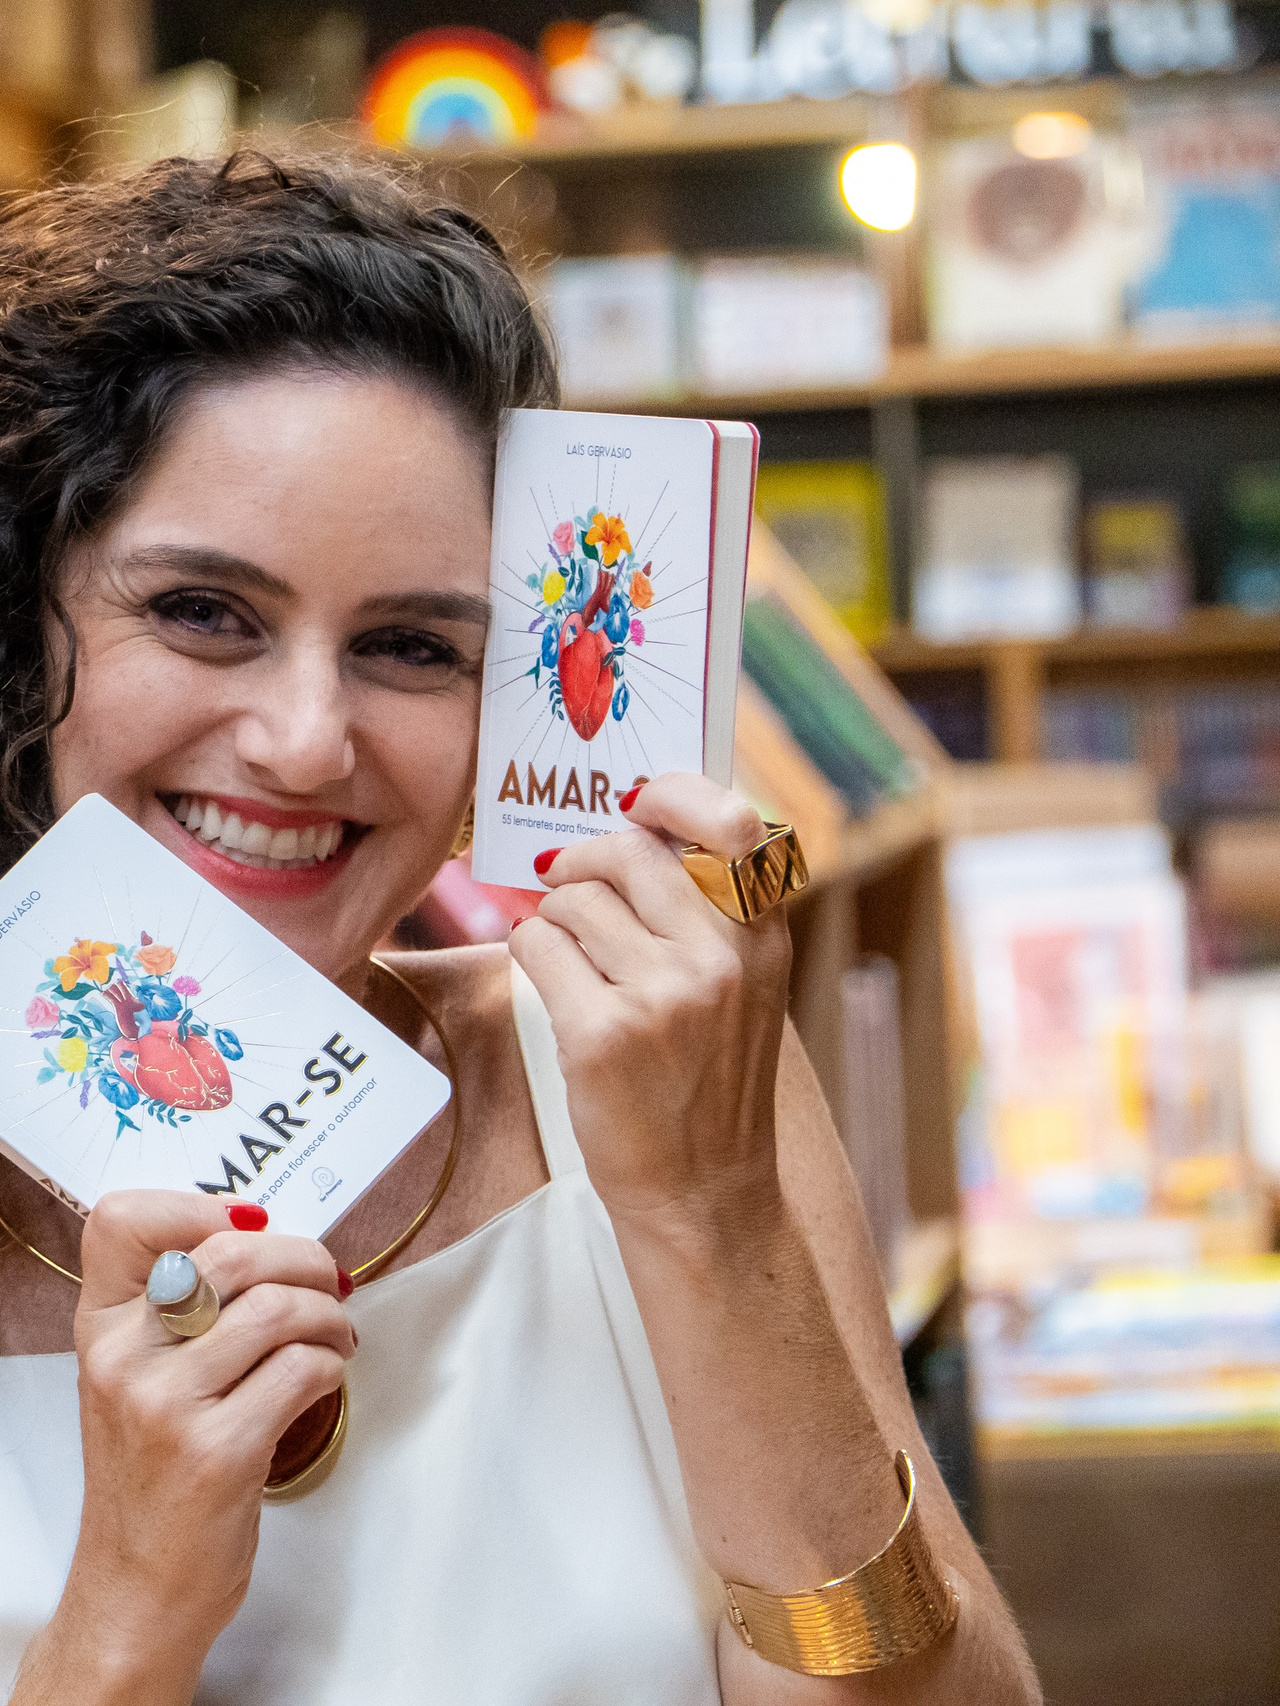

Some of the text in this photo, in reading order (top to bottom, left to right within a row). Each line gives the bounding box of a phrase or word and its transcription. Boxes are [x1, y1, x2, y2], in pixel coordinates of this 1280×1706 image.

[566, 442, 632, 460] LAÍS GERVÁSIO
[497, 759, 651, 816] AMAR-
[501, 813, 512, 825] 55
[513, 815, 554, 831] lembretes
[555, 823, 575, 834] para
[194, 1030, 369, 1196] MAR-SE
[268, 1077, 378, 1196] para florescer o autoamor
